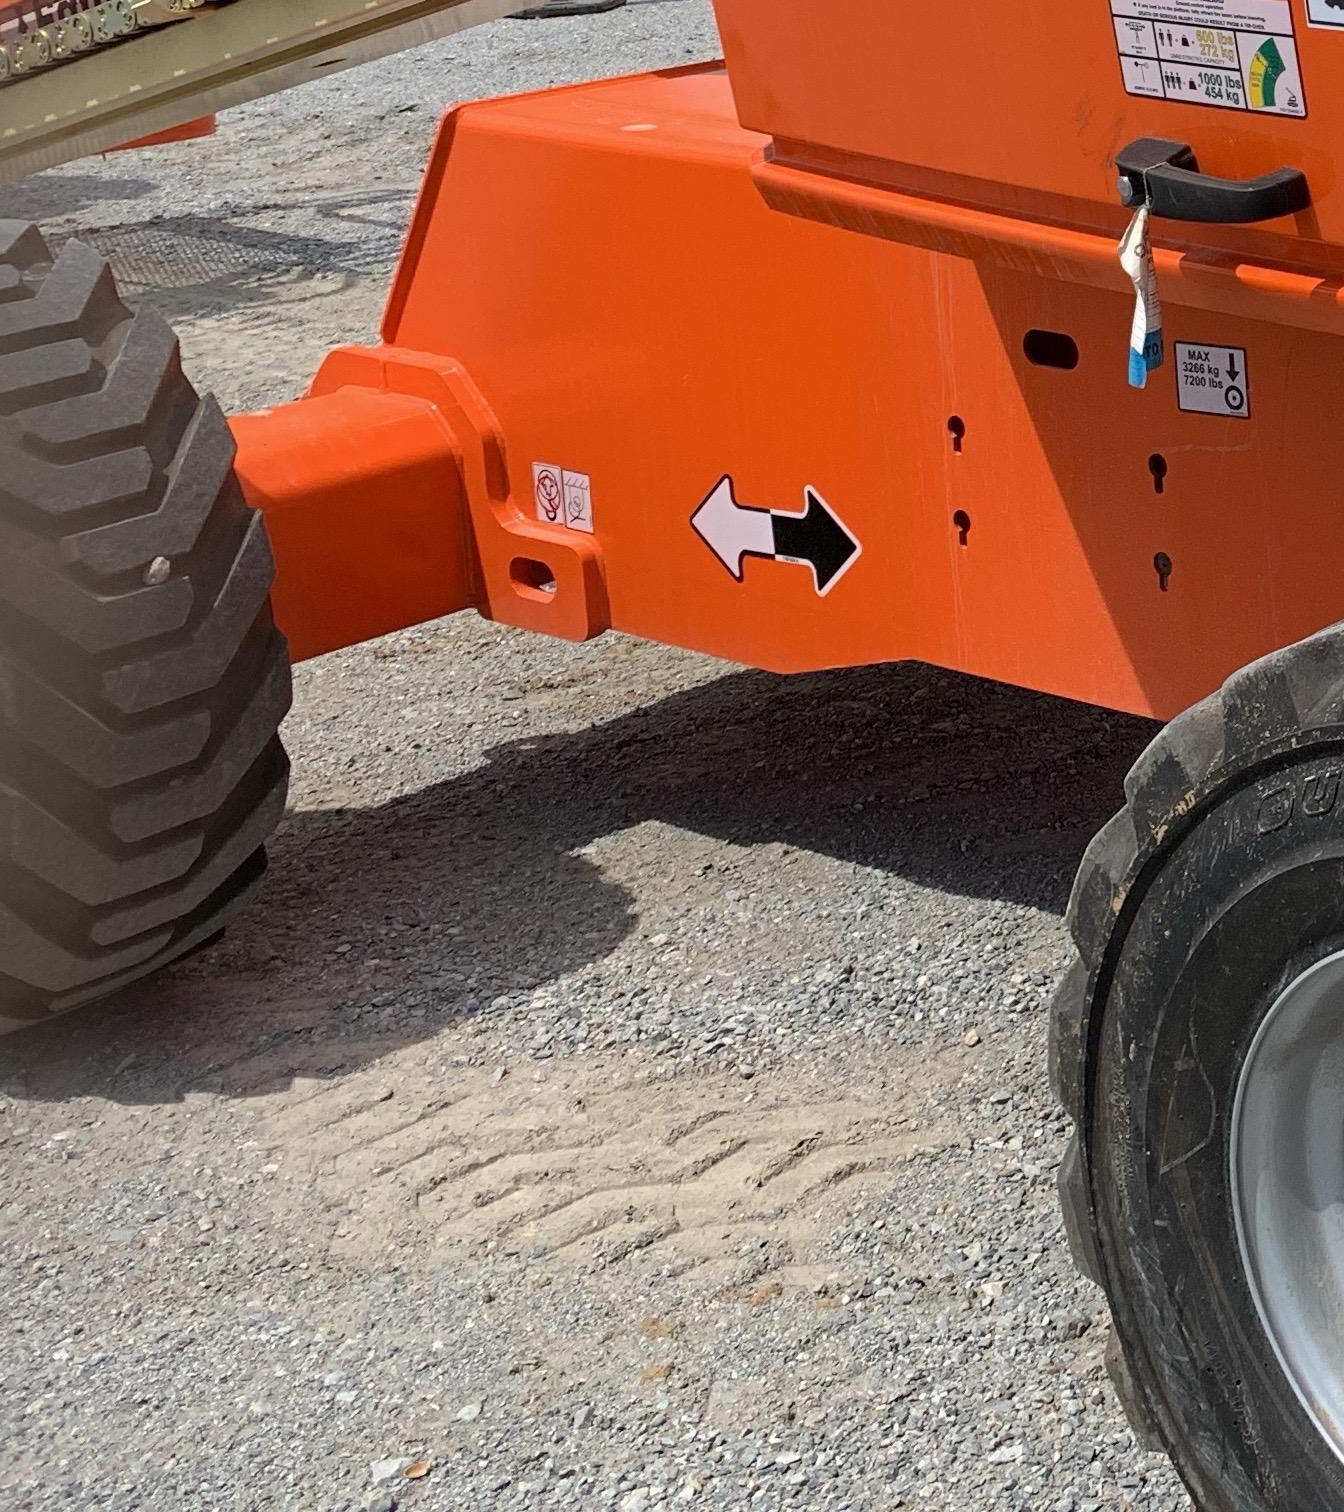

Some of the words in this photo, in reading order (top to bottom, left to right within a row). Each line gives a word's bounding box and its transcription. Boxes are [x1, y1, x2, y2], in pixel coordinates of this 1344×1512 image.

[1195, 29, 1215, 44] 600
[1216, 31, 1234, 47] lbs
[1199, 42, 1219, 58] 272
[1220, 46, 1235, 63] kg
[1198, 72, 1222, 87] 1000
[1224, 75, 1242, 90] lbs
[1204, 87, 1224, 102] 454
[1226, 90, 1240, 106] kg
[1187, 349, 1211, 363] MAX
[1182, 361, 1206, 376] 3266
[1207, 364, 1220, 379] kg
[1183, 374, 1207, 388] 7200
[1208, 376, 1224, 390] lbs
